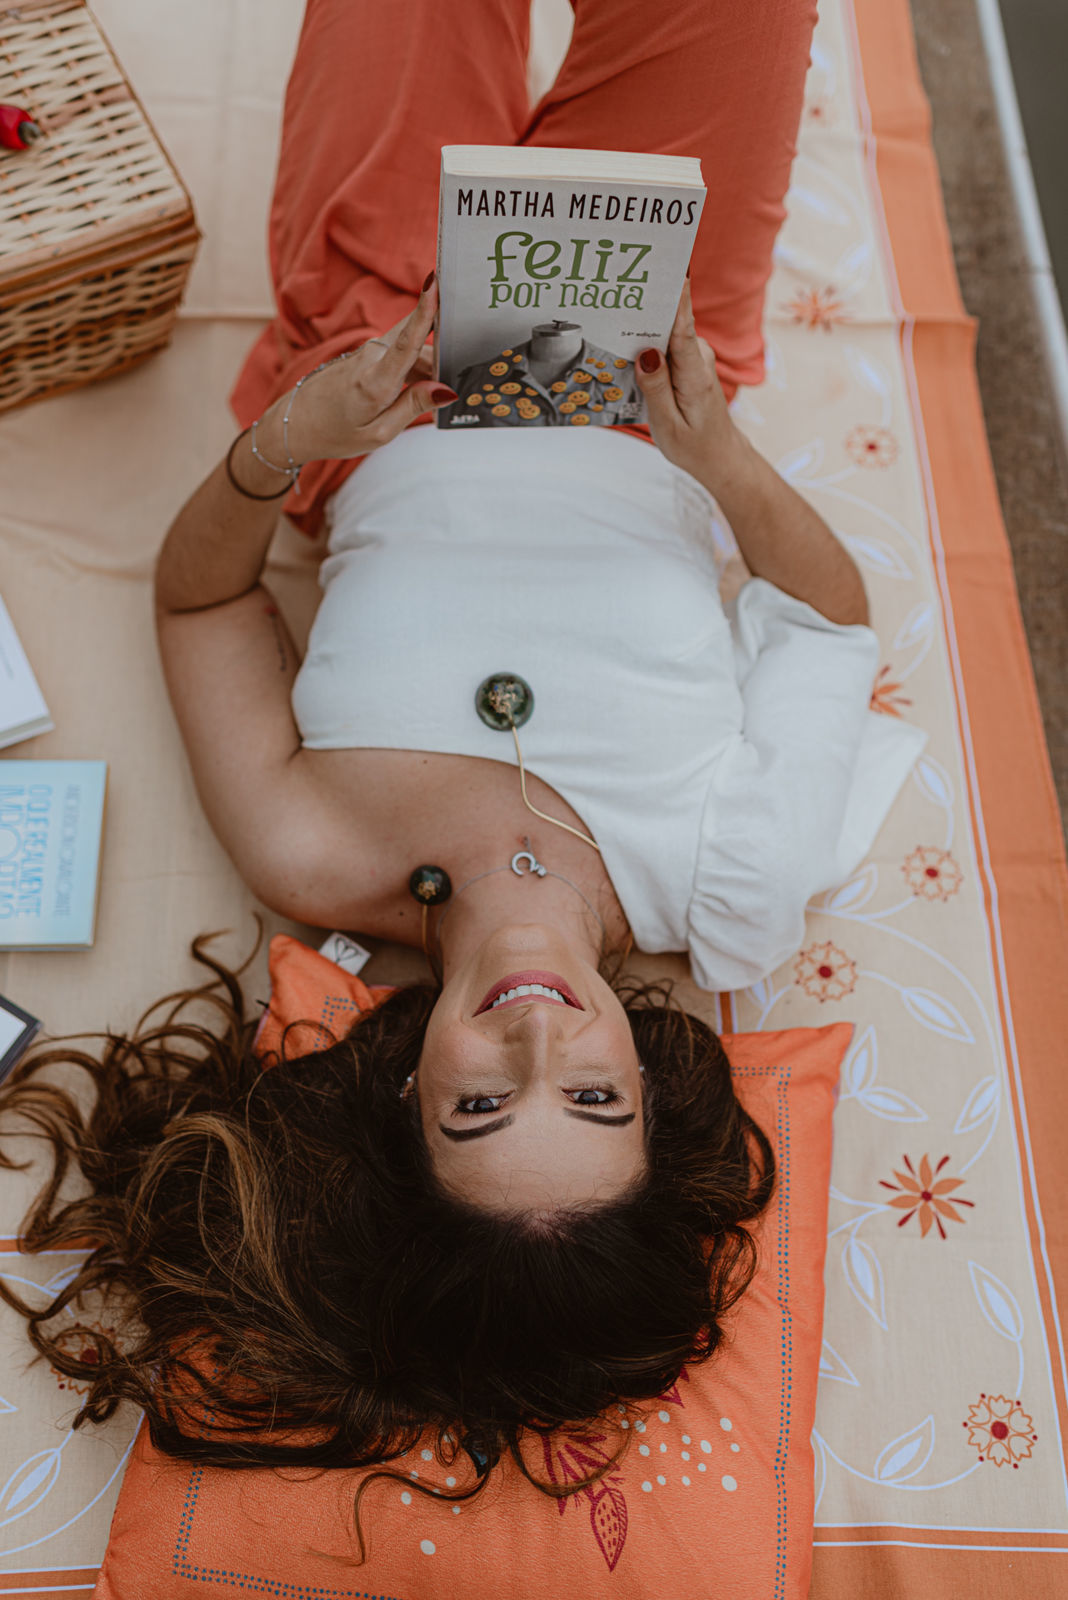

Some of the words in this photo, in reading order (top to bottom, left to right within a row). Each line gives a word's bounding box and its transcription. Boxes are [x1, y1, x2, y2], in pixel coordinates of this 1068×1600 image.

[457, 188, 555, 218] MARTHA
[568, 193, 697, 226] MEDEIROS
[487, 230, 652, 283] feliz
[488, 282, 551, 309] por
[558, 282, 644, 310] nada
